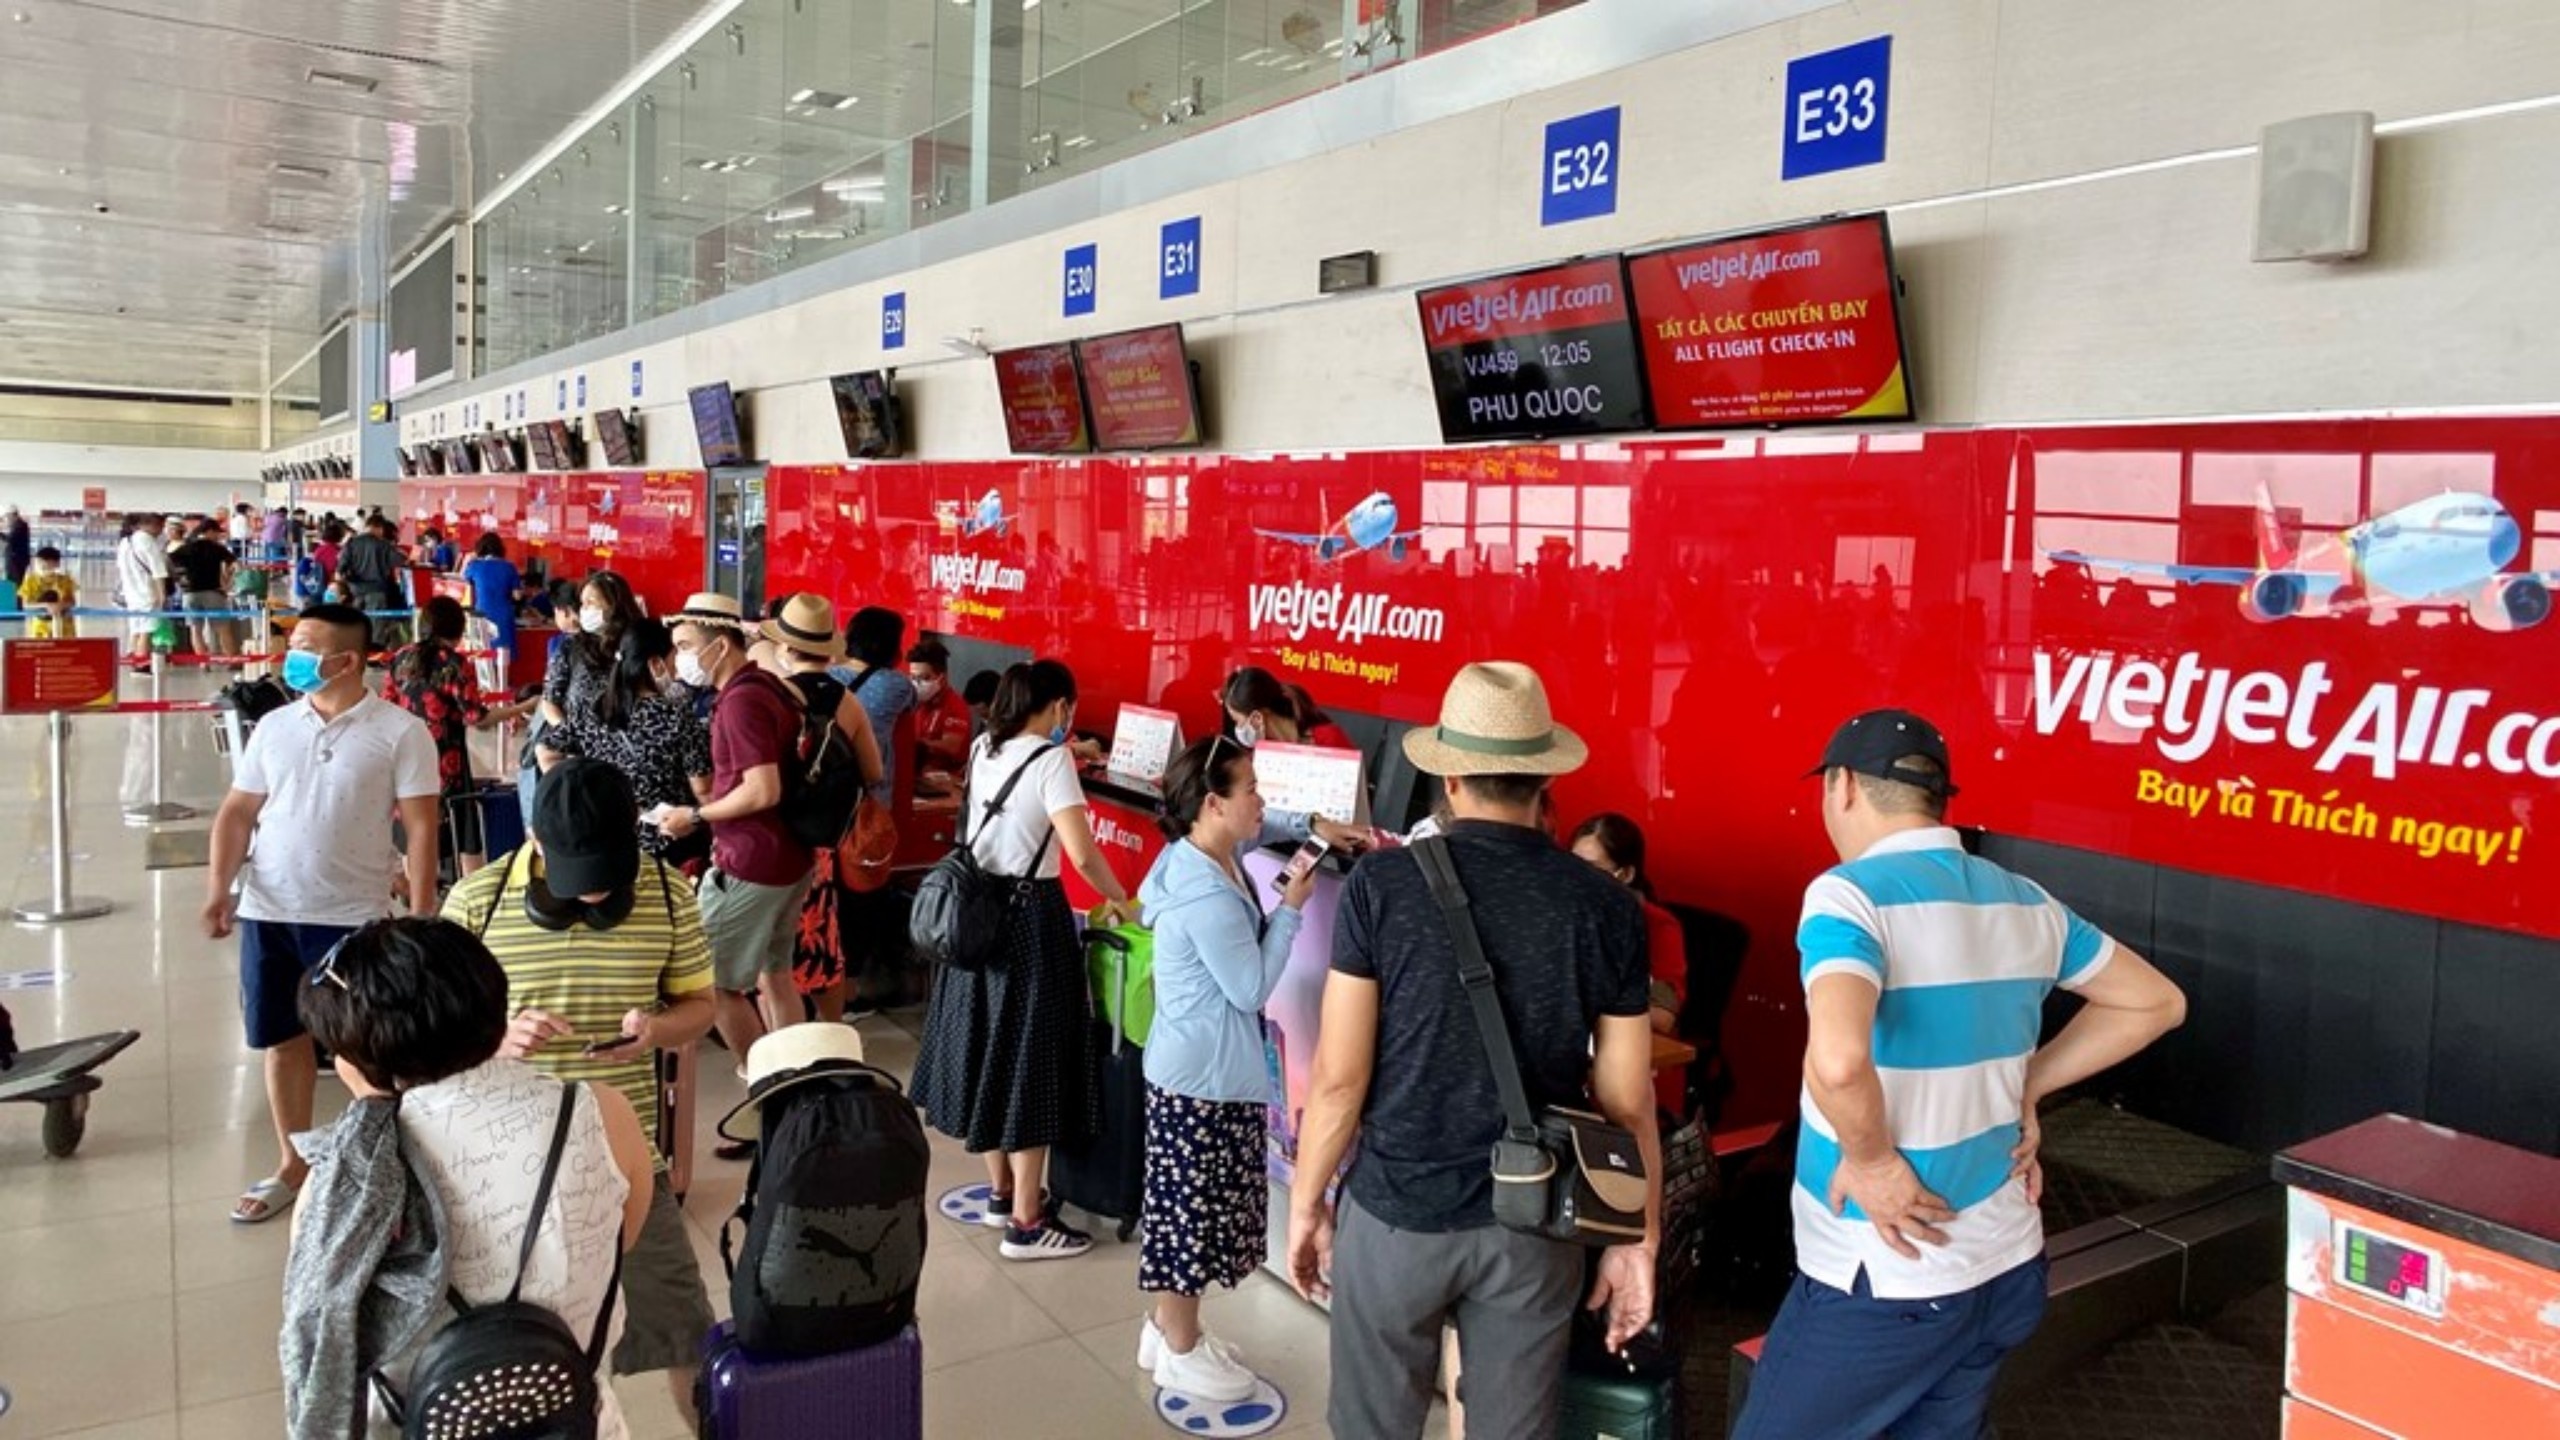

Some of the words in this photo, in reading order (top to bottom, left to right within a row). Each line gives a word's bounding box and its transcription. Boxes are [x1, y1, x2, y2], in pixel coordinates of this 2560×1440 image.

[1796, 77, 1876, 143] E33
[1552, 141, 1609, 195] E32
[1164, 240, 1193, 277] E31
[1066, 265, 1093, 298] E30
[885, 310, 902, 333] E29
[1714, 310, 1747, 334] CÁC
[1829, 300, 1868, 321] BAY
[1464, 350, 1519, 376] VJ459
[1540, 340, 1592, 368] 12:05
[1674, 345, 1703, 363] ALL
[1707, 338, 1764, 359] FLIGHT
[1770, 330, 1856, 354] CHECK-IN
[1468, 393, 1519, 423] PHU
[1524, 385, 1603, 418] QUOC
[1281, 647, 1306, 672] Bay
[1322, 652, 1357, 675] Thích
[2137, 769, 2210, 816] Bay
[2218, 776, 2254, 818] là
[2267, 788, 2377, 839] Thích
[2390, 815, 2524, 866] ngay!
